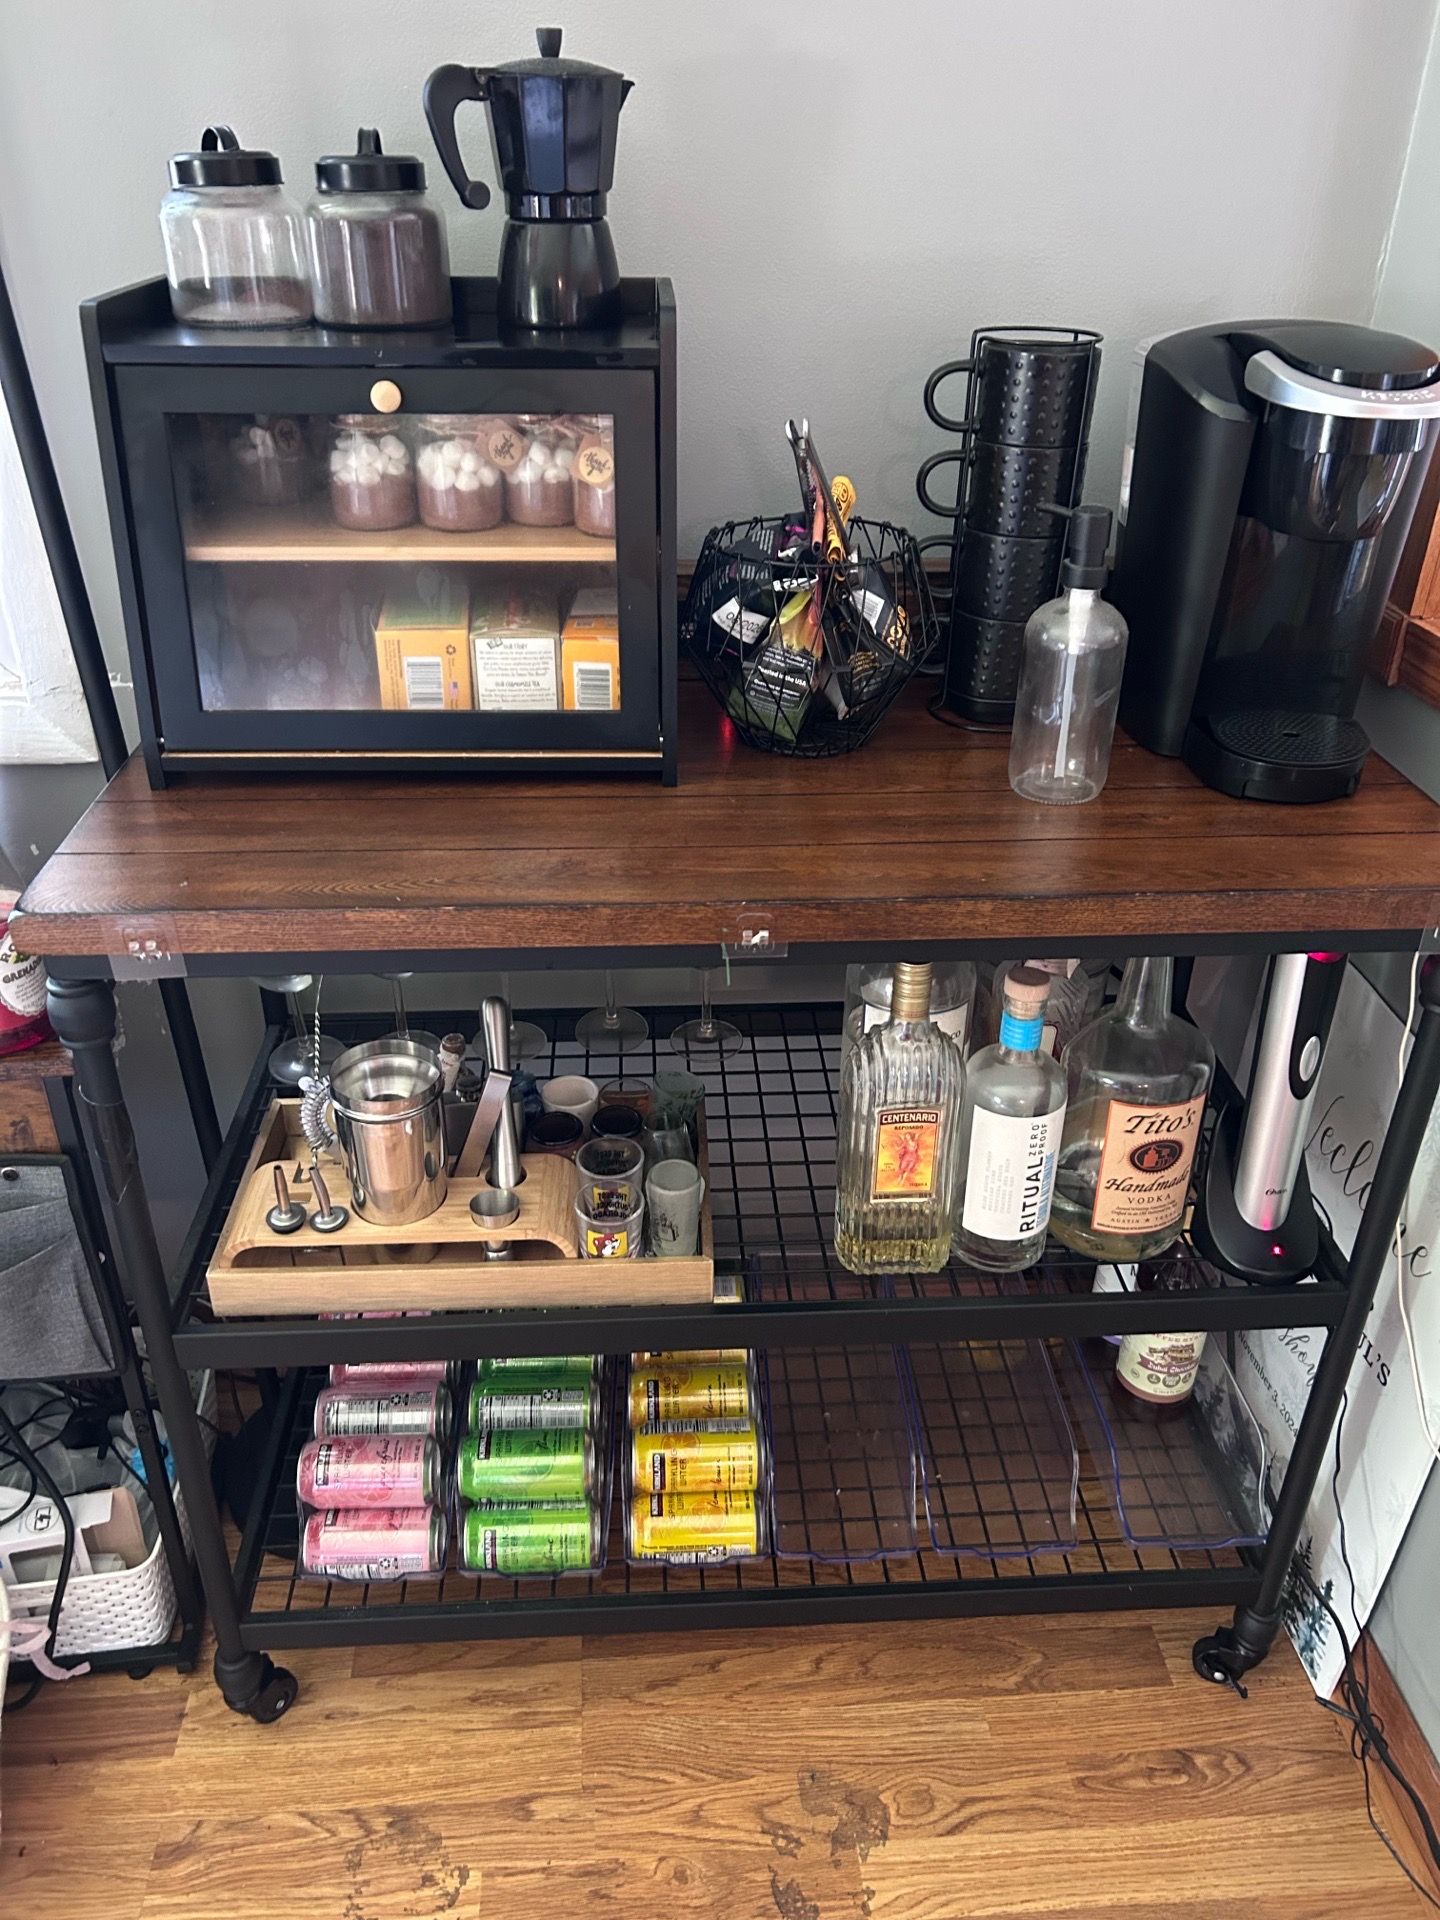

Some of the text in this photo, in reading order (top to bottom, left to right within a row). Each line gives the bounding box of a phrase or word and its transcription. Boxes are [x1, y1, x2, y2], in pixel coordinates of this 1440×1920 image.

[795, 677, 807, 687] USA
[882, 1113, 936, 1123] CENTENARIO
[1124, 1108, 1196, 1135] Tito's
[1029, 1124, 1040, 1157] ZERO
[1038, 1123, 1048, 1156] PROOF
[1019, 1156, 1044, 1233] RITUAL
[1128, 1193, 1171, 1204] VODKA
[1237, 1330, 1272, 1391] November
